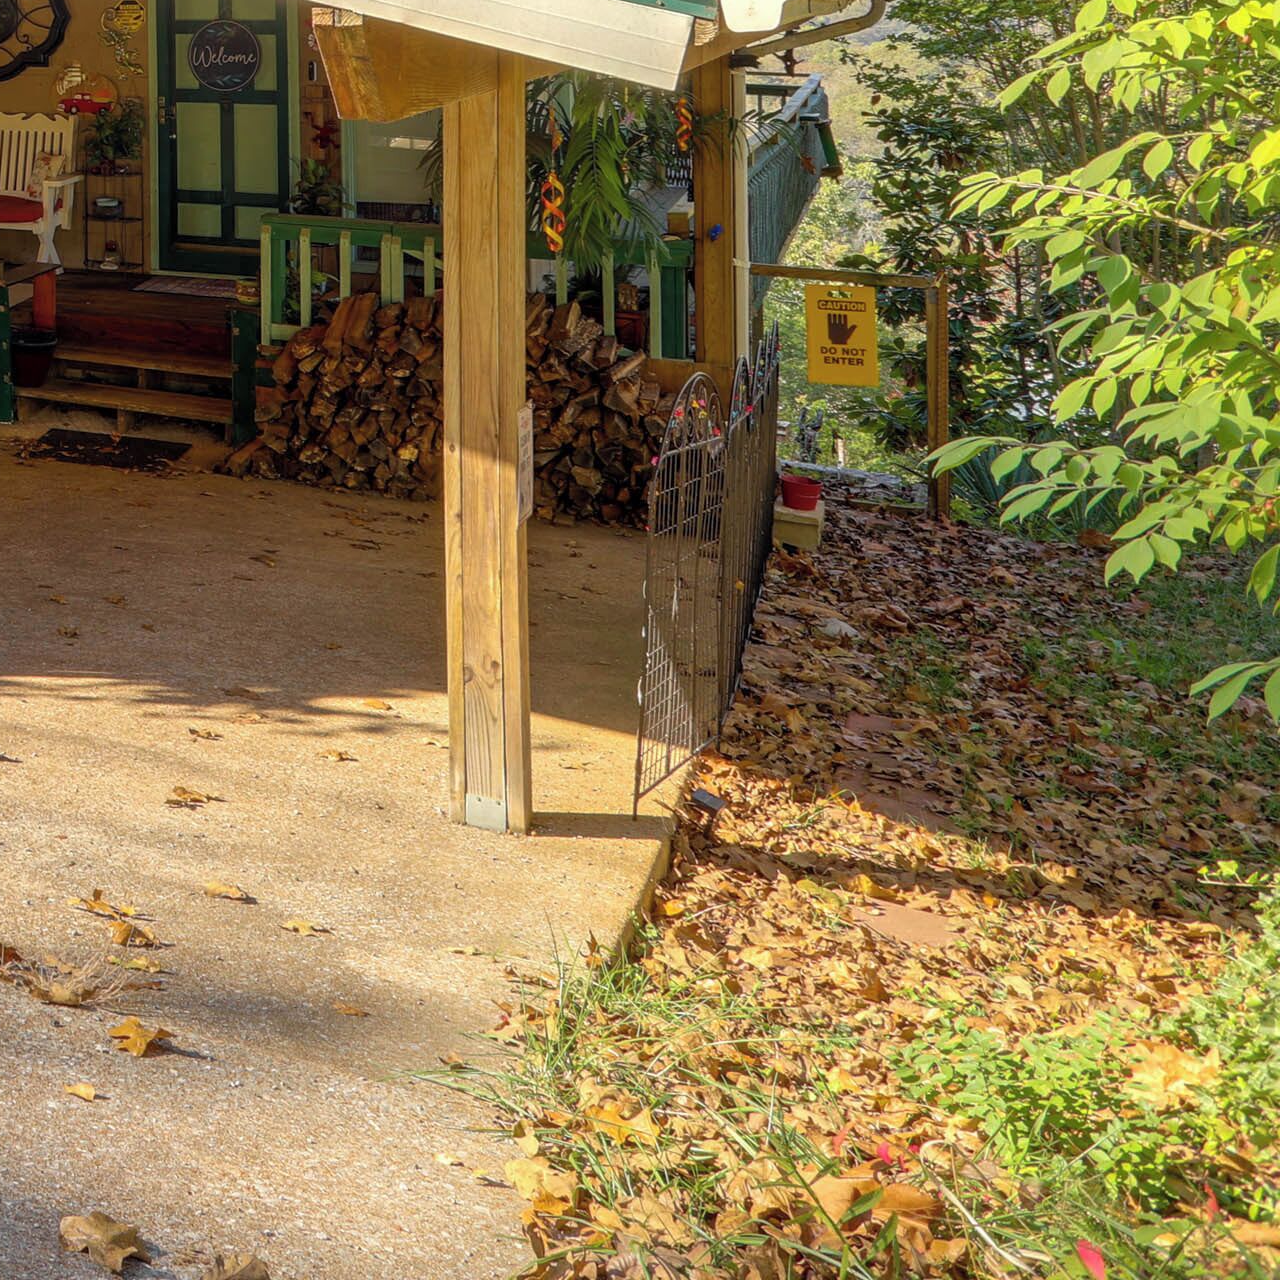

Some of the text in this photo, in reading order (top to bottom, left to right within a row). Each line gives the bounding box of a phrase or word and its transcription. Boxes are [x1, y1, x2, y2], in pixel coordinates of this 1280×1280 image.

[193, 46, 257, 67] Welcome
[819, 300, 865, 311] CAUTION
[820, 346, 867, 357] DO NOT
[824, 356, 864, 366] ENTER
